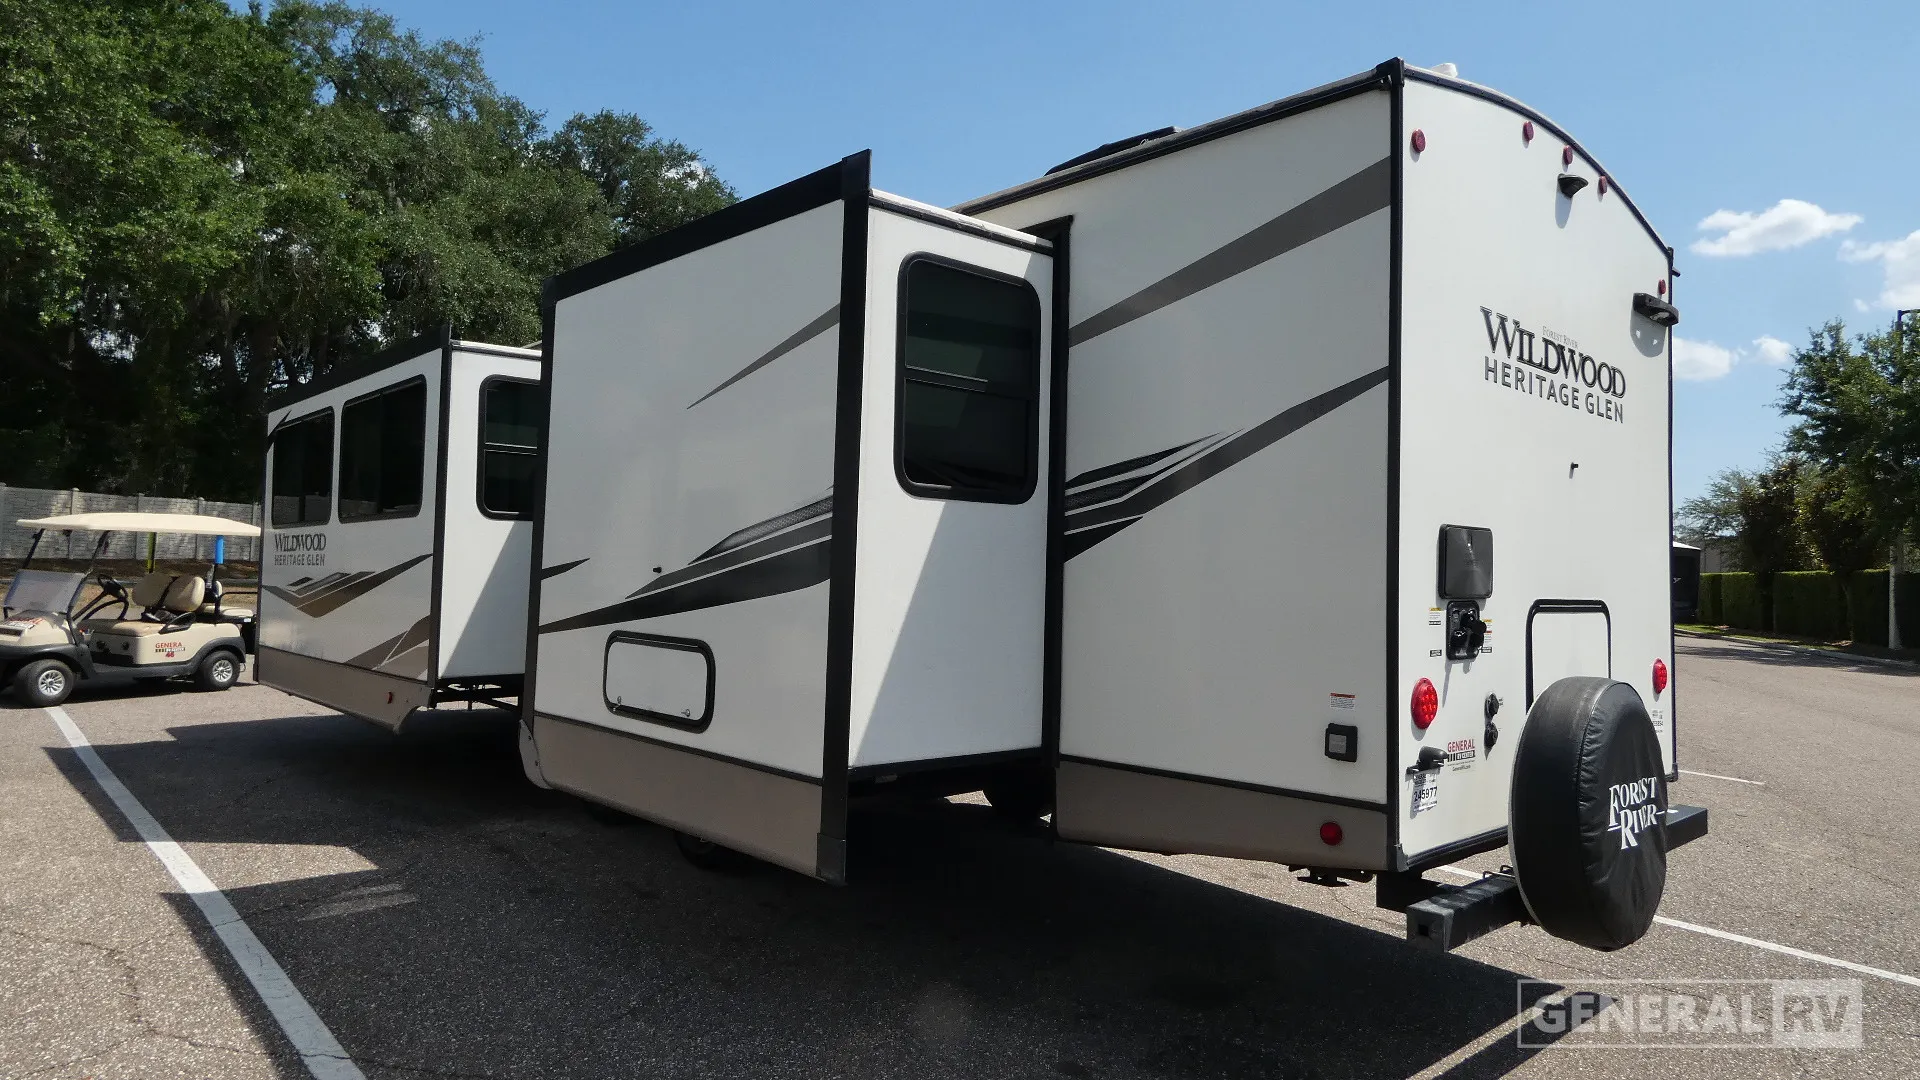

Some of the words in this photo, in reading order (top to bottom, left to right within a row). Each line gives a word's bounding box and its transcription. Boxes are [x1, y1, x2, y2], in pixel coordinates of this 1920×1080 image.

[1480, 305, 1626, 399] WILDWOOD
[1484, 355, 1580, 410] HERITAGE
[1585, 393, 1624, 424] GLEN
[274, 532, 327, 552] WILDWOOD
[274, 553, 305, 567] HERITAGE
[306, 553, 326, 567] GLEN
[1447, 739, 1475, 752] GENERAL
[1413, 786, 1437, 802] 245977
